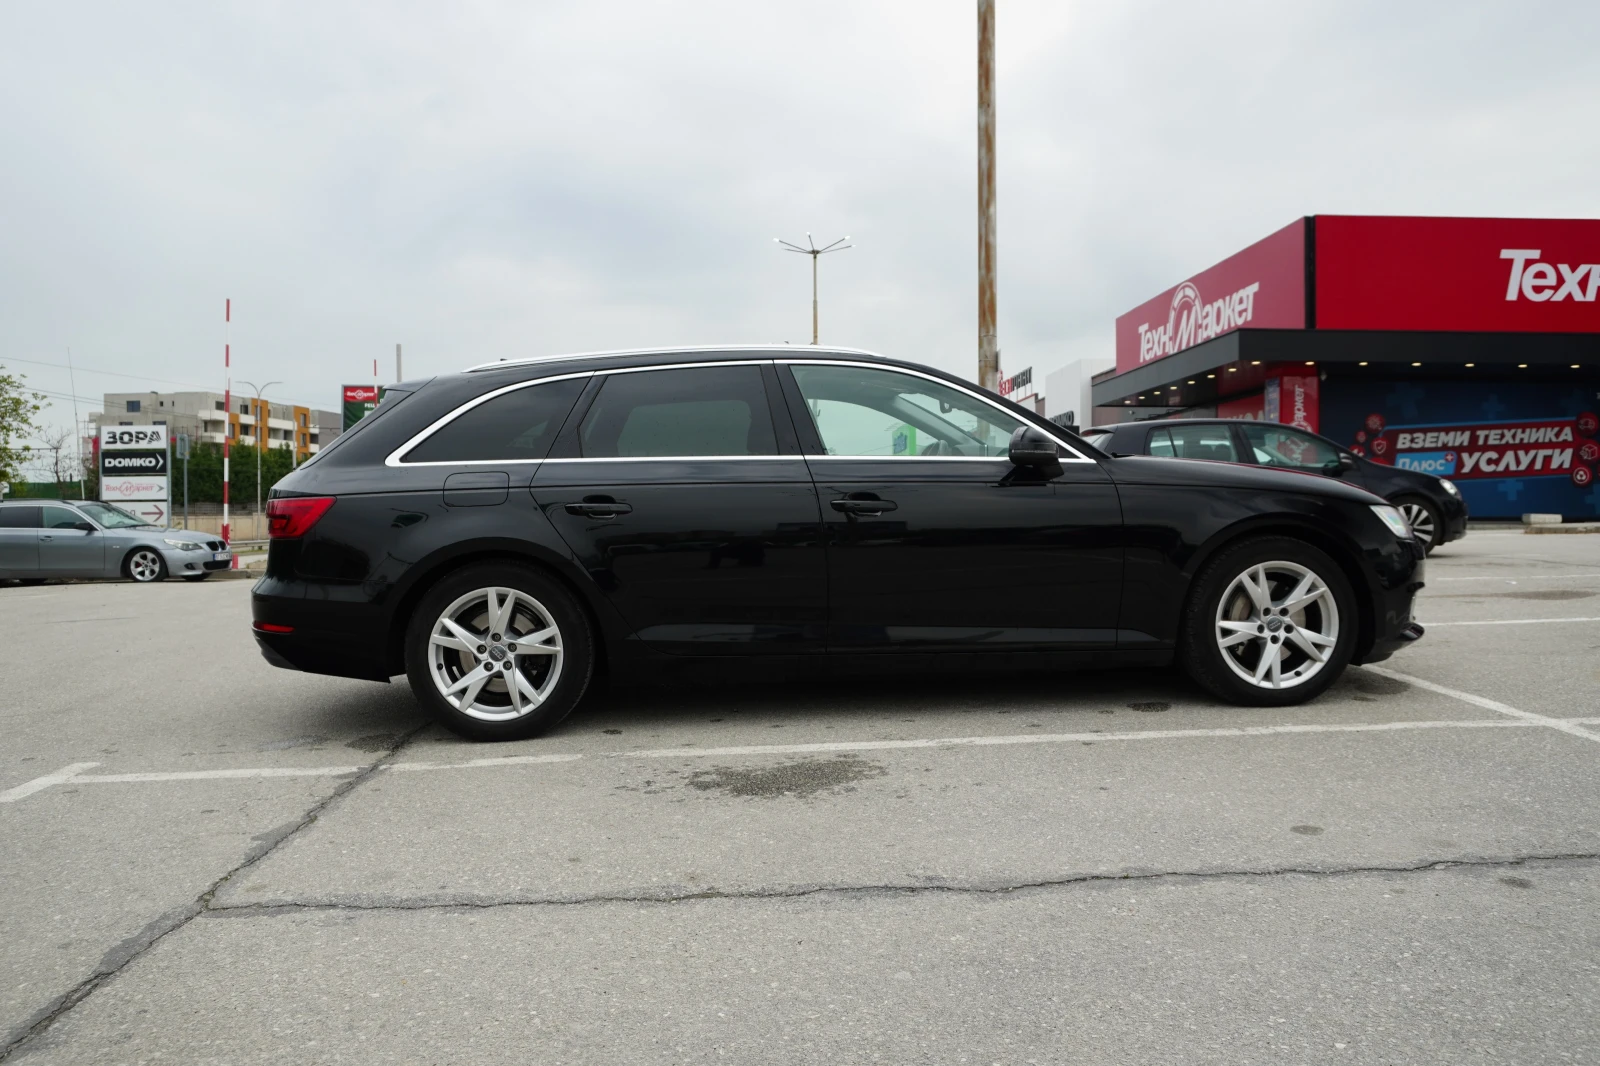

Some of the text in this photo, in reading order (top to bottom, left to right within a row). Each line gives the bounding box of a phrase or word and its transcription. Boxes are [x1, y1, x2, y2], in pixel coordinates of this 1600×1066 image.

[105, 431, 161, 444] ЗОРА
[1396, 426, 1573, 449] ВЗЕМИ ТЕХНИКА
[104, 457, 156, 467] DOMKO
[1460, 448, 1574, 473] УСЛУГИ
